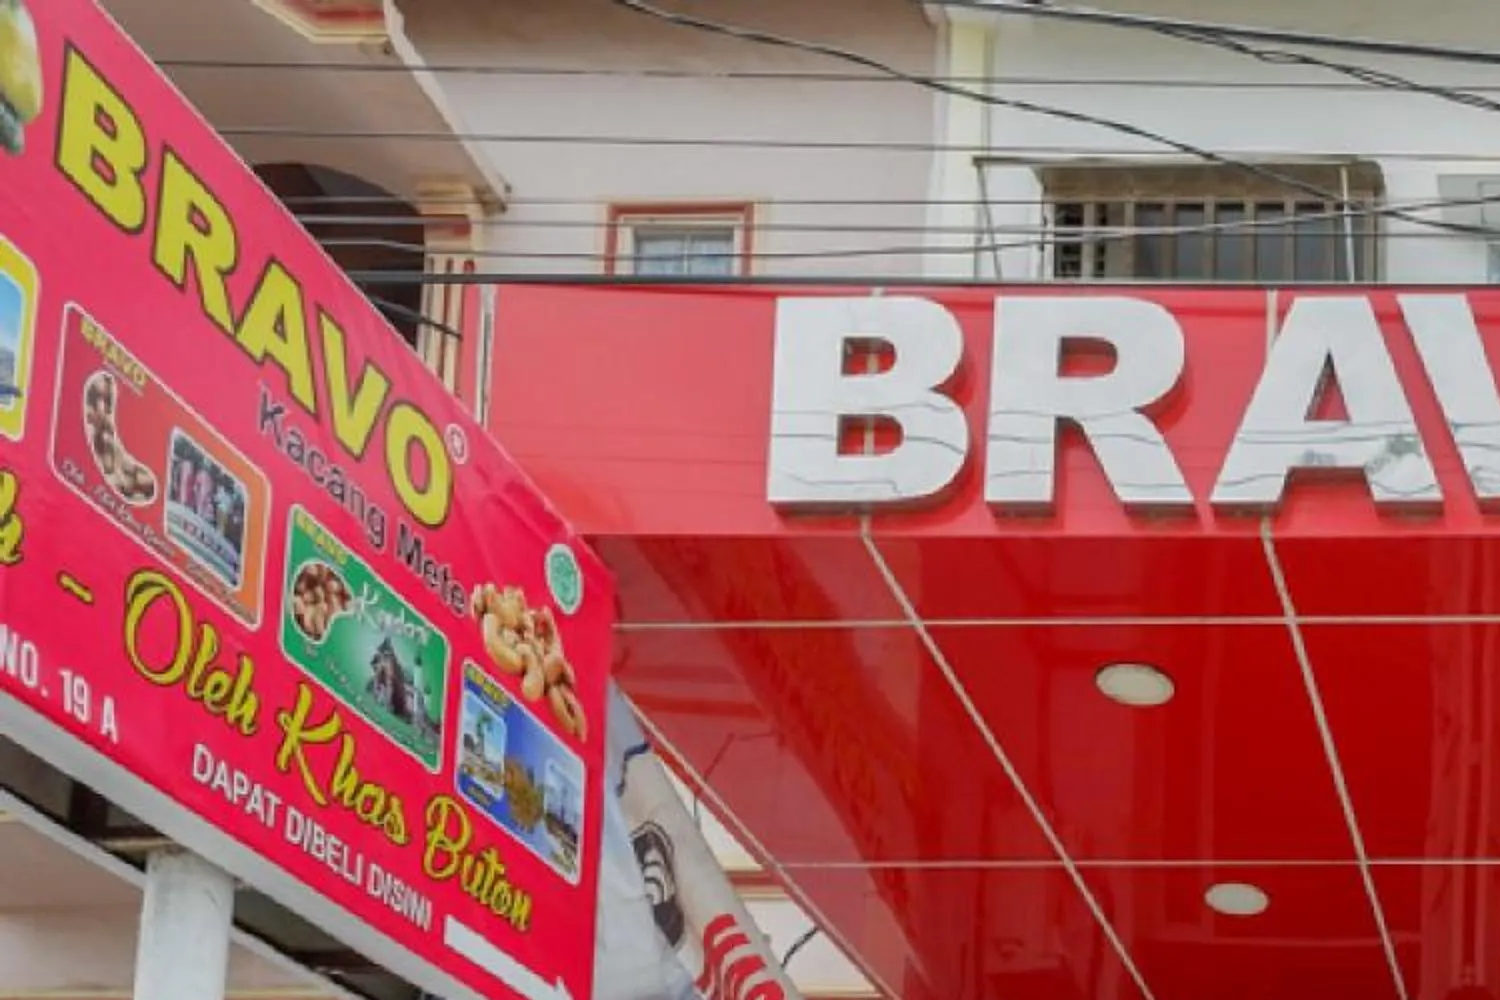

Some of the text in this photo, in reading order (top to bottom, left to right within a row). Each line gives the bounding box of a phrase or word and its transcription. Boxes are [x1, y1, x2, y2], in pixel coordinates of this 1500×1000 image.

[55, 38, 455, 529] BRAVO
[258, 384, 386, 554] Kacang
[394, 518, 468, 616] Mete
[60, 669, 90, 723] 19
[101, 696, 119, 743] A
[124, 568, 259, 735] Oleh
[274, 681, 410, 846] Khas
[423, 793, 533, 932] Buton
[192, 743, 432, 932] DAPAT DIBELI DISINI
